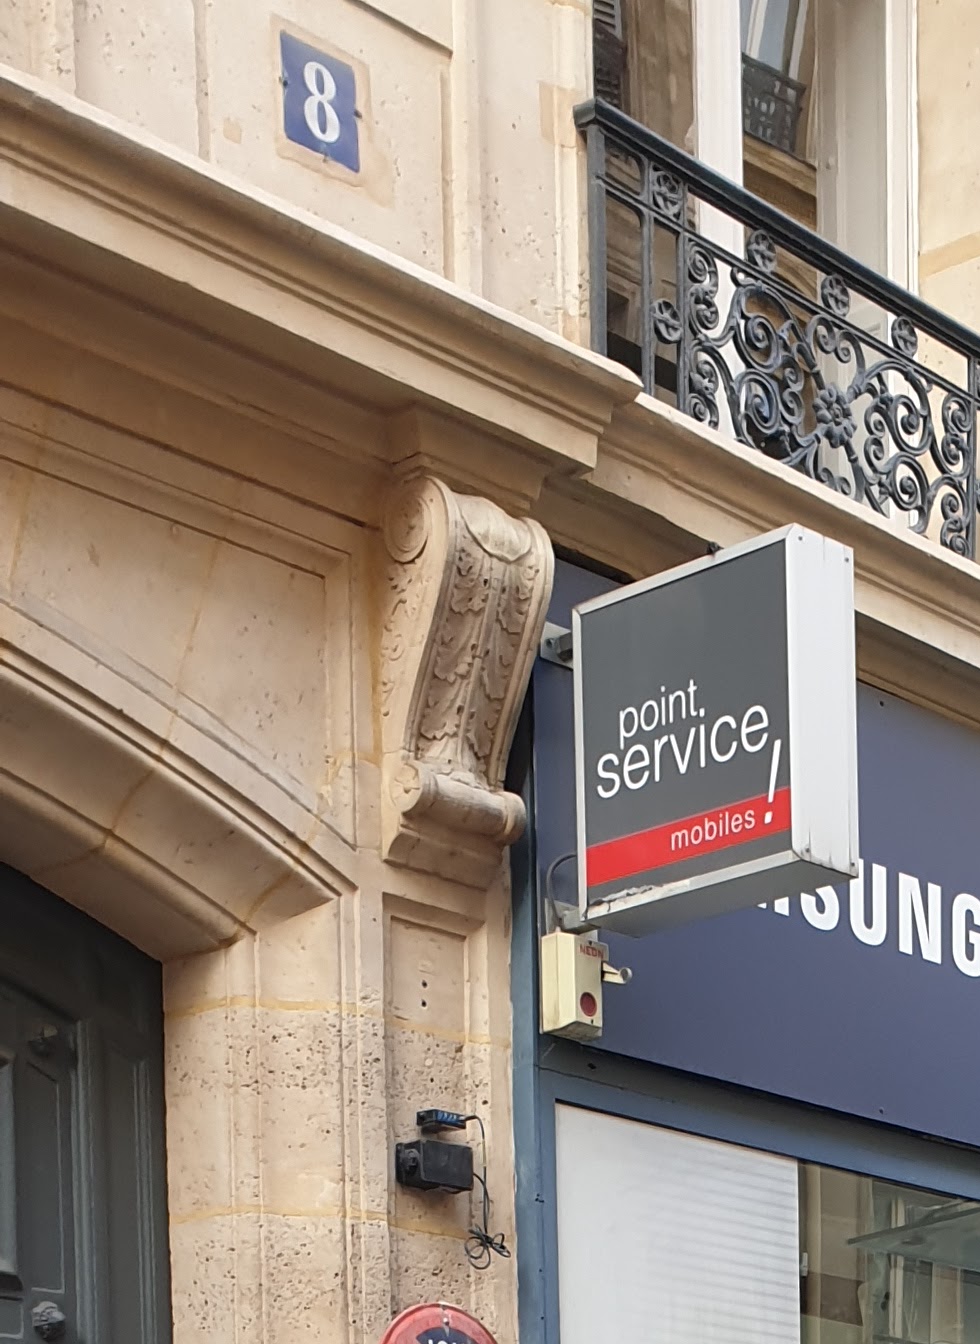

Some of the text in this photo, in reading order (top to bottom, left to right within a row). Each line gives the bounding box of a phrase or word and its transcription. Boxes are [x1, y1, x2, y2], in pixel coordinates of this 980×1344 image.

[303, 60, 341, 145] 8
[618, 679, 698, 750] point
[670, 807, 757, 852] mobiles
